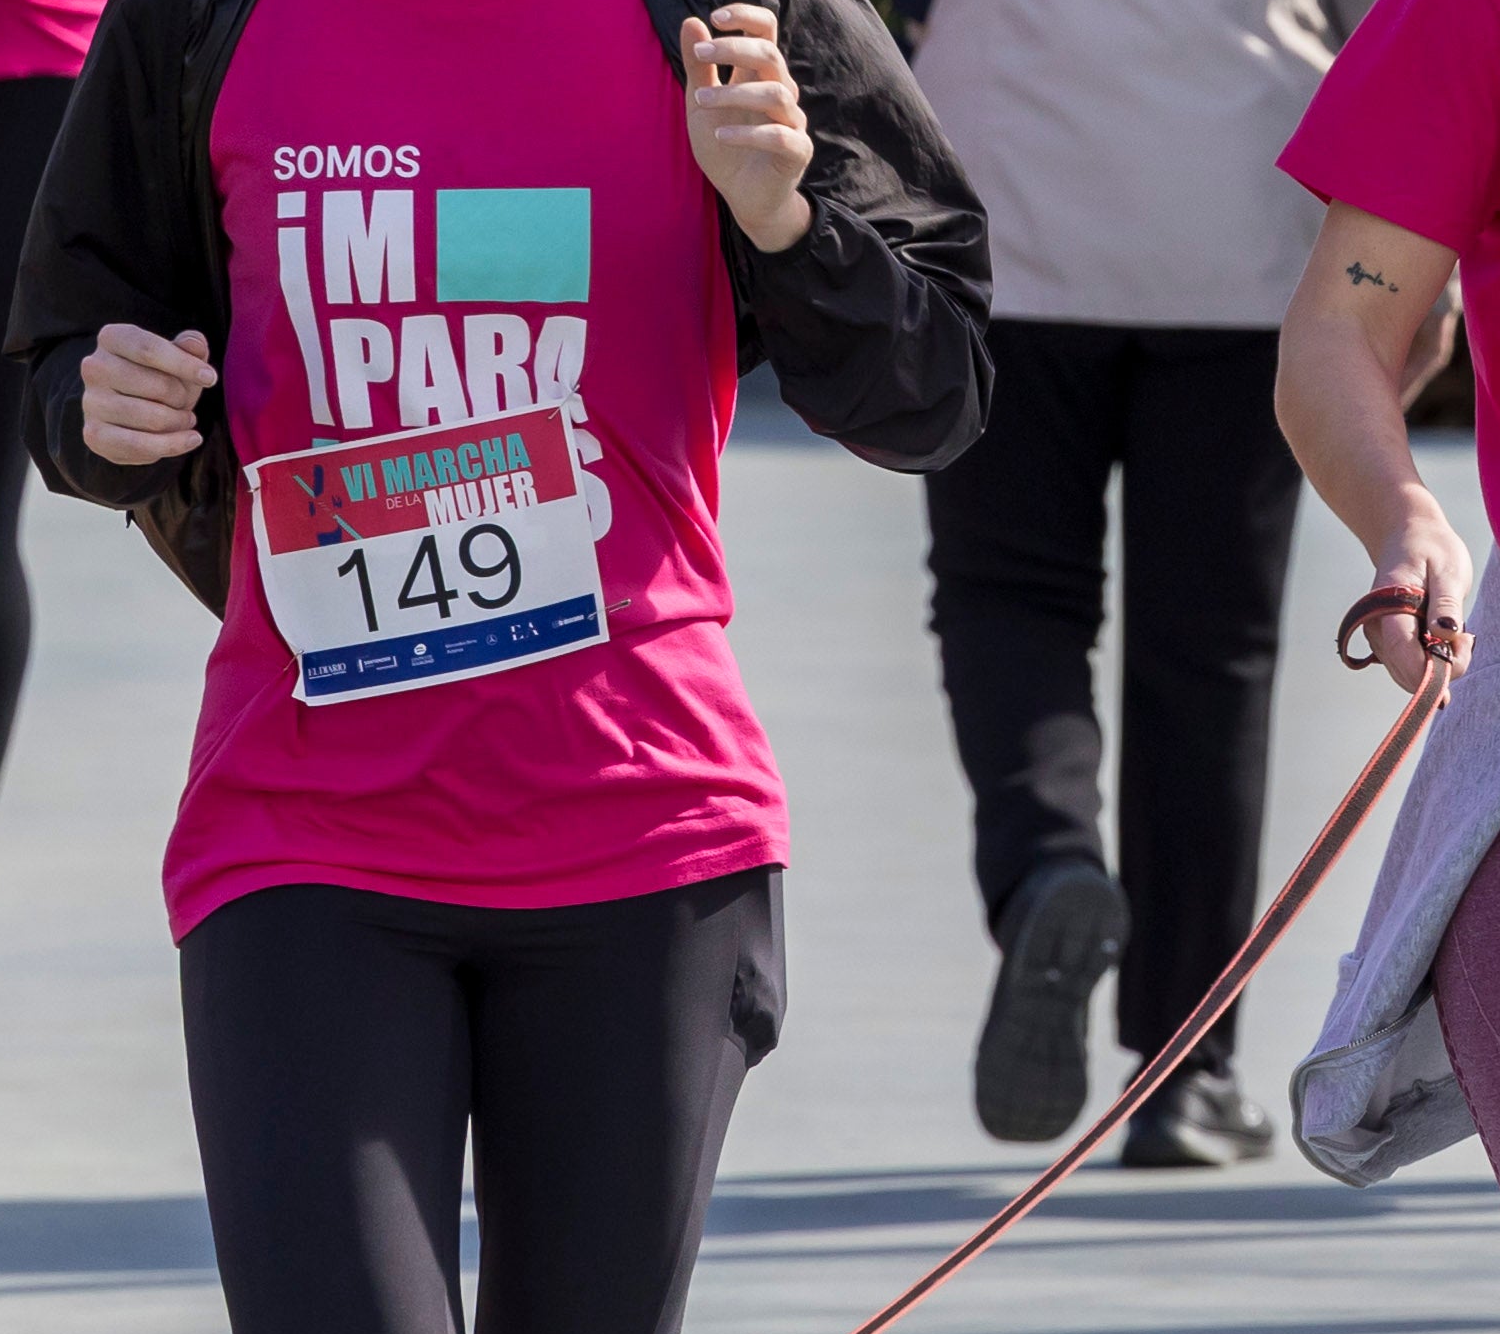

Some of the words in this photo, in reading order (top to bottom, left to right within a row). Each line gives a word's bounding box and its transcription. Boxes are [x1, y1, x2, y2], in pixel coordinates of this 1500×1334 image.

[273, 145, 421, 180] SOMOS
[339, 462, 377, 502] VI
[380, 433, 532, 496] MARCHA
[385, 496, 403, 511] DE
[404, 493, 422, 508] LA
[423, 470, 539, 528] MUJER
[337, 523, 522, 633] 149
